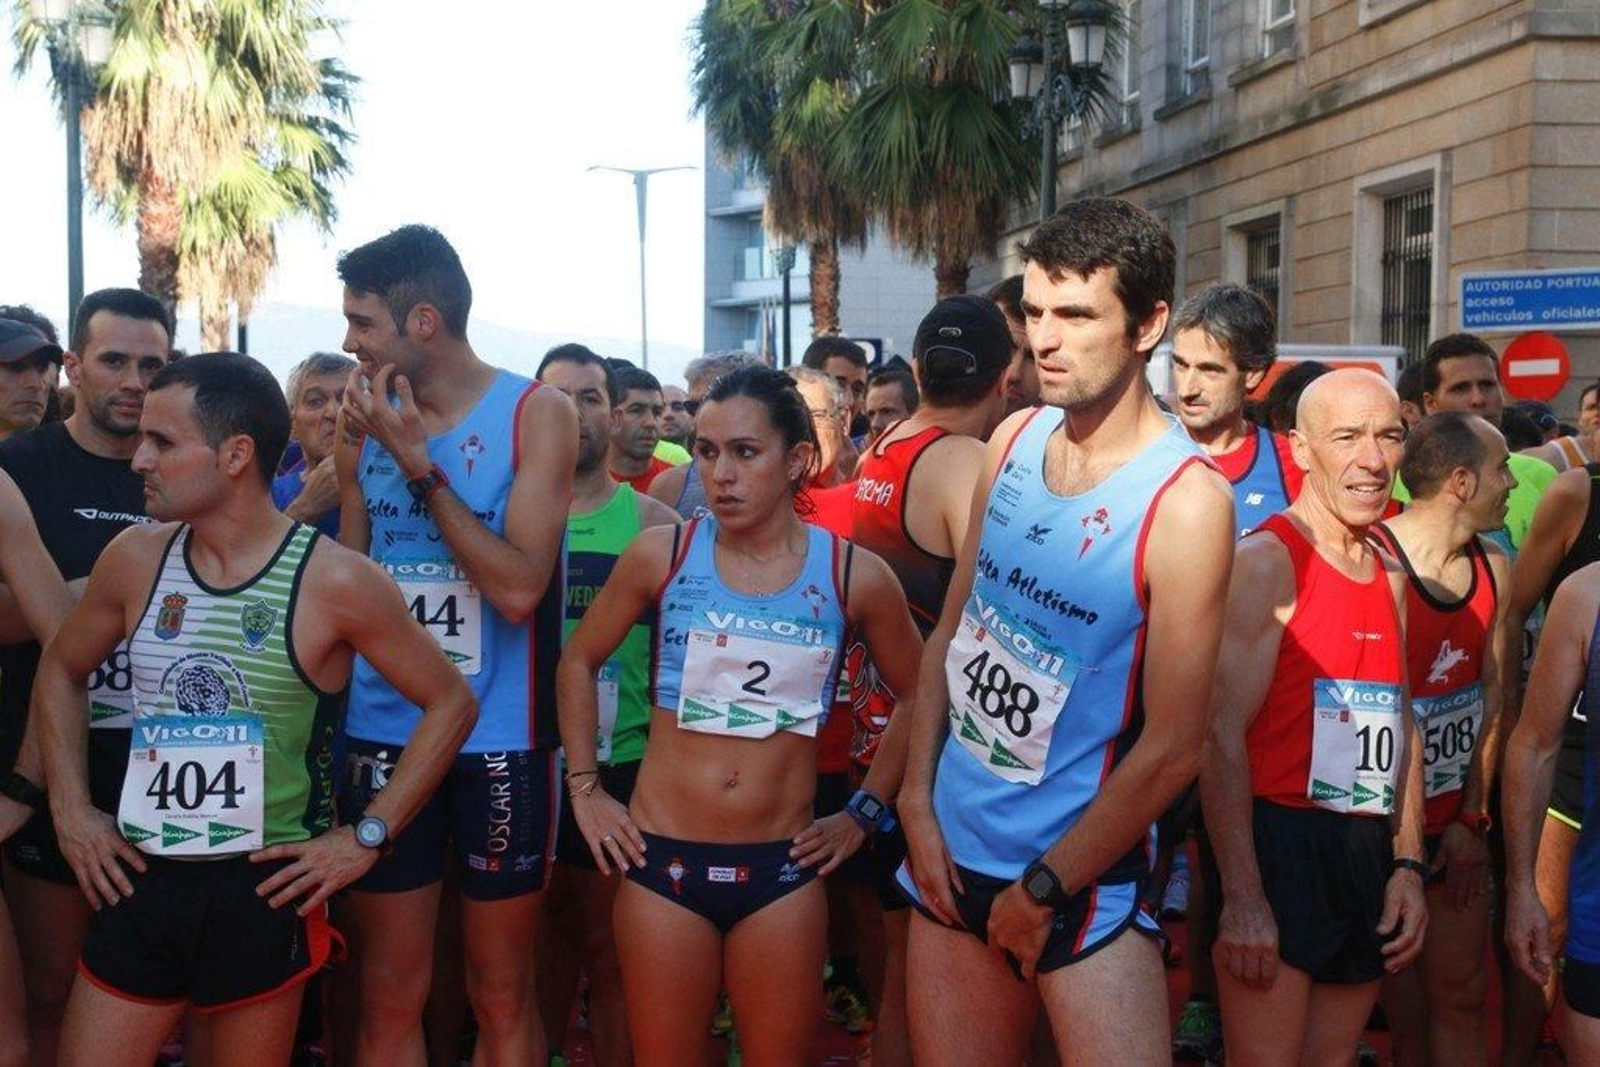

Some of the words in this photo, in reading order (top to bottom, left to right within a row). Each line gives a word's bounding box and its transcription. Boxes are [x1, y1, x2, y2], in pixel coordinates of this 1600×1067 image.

[1465, 278, 1543, 292] AUTORIDAD
[1465, 296, 1515, 308] acceso
[1541, 306, 1600, 320] oficiales
[1005, 567, 1099, 626] Atletismo
[741, 660, 771, 696] 2
[963, 650, 1039, 738] 488
[1355, 724, 1394, 773] 10
[1424, 716, 1475, 766] 508
[145, 760, 246, 810] 404
[488, 782, 511, 852] OSCAR
